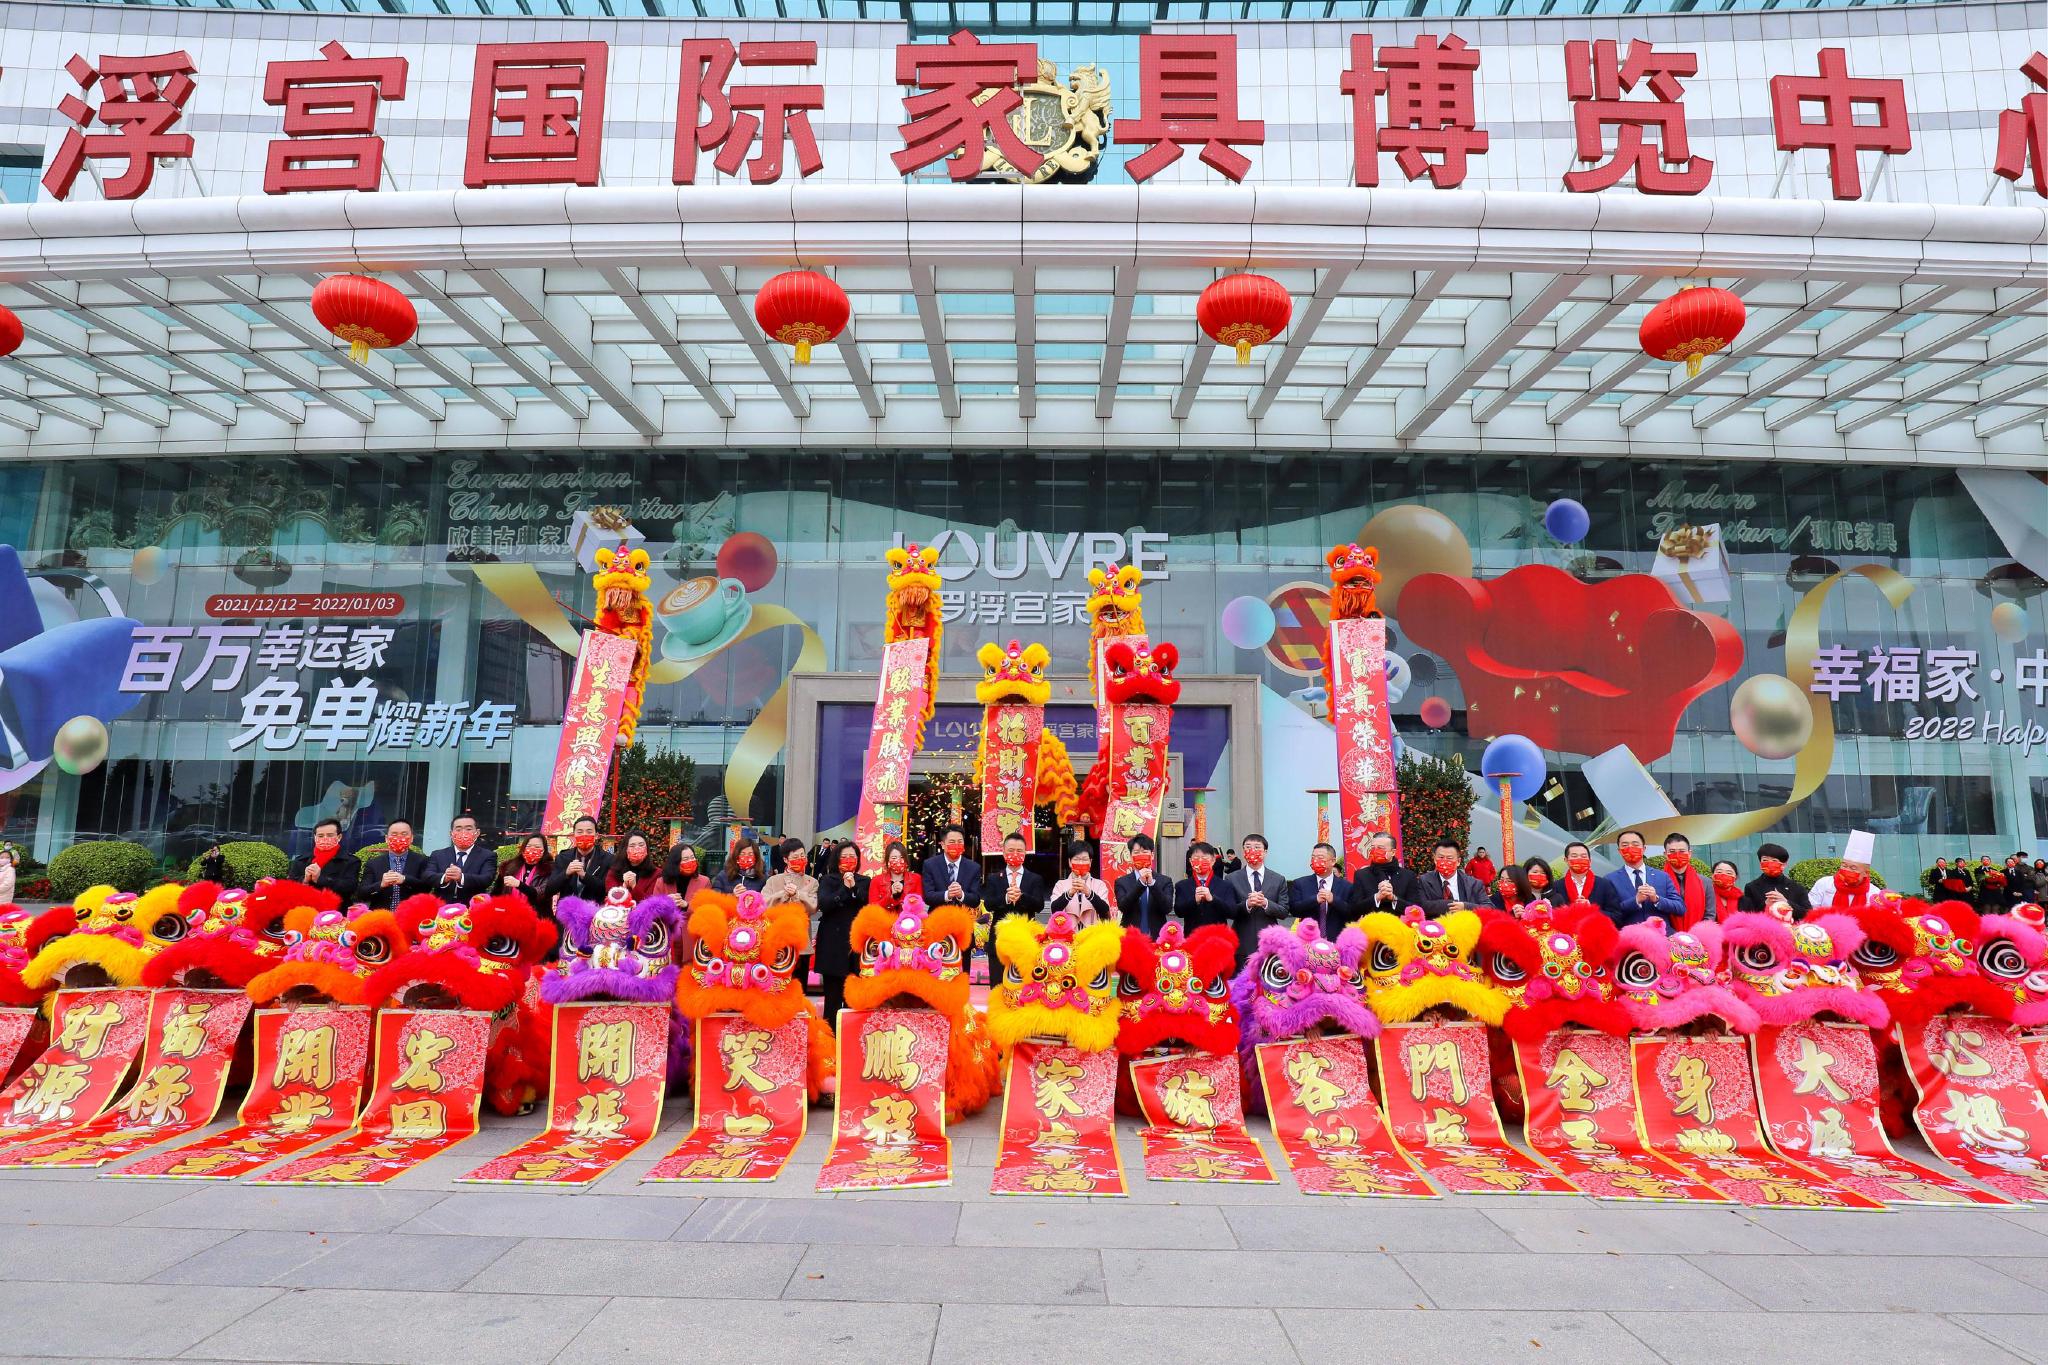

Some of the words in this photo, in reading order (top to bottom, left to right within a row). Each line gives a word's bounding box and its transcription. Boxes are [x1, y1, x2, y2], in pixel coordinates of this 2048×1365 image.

[1646, 480, 1757, 510] Modern
[447, 525, 573, 556] 欧美古典家
[118, 624, 396, 693] 百万幸运家
[228, 676, 517, 755] 免单耀新年
[1905, 716, 1976, 740] 2022
[1982, 709, 2048, 758] Hap
